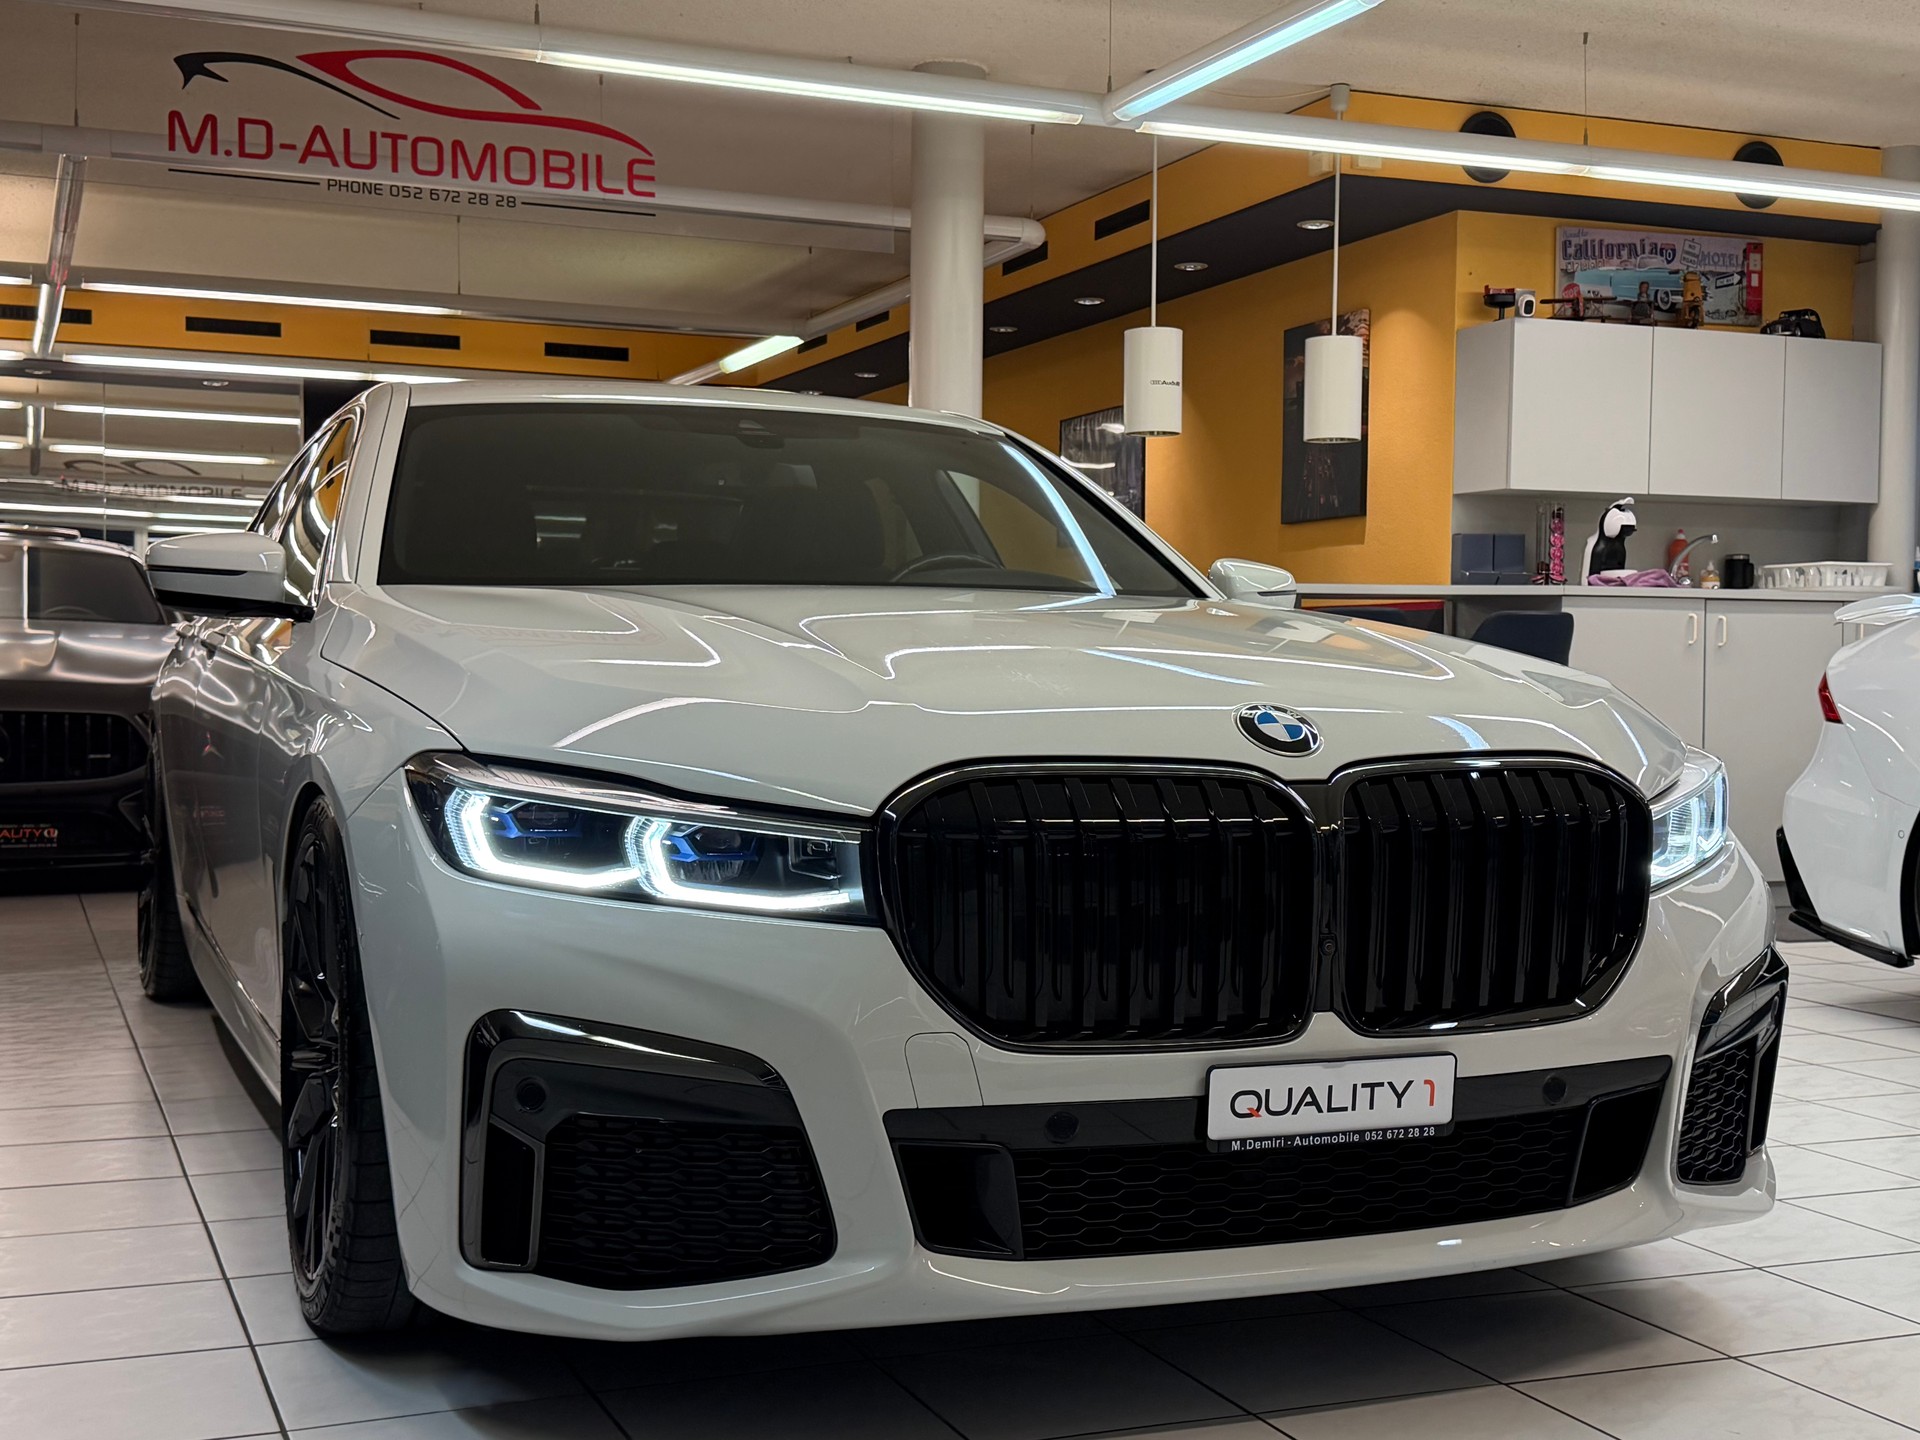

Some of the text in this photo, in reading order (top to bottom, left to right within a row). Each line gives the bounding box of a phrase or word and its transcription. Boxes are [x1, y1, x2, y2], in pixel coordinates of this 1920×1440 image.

[168, 110, 656, 198] M.D-AUTOMOBILE
[327, 178, 517, 208] PHONE 052 672 28 28
[1562, 239, 1658, 260] California
[1662, 248, 1674, 261] 10
[1700, 251, 1741, 267] MOTEL
[1240, 704, 1302, 719] BMW
[1230, 1079, 1436, 1119] QUALITY 1
[1293, 1132, 1360, 1147] Automobile
[1365, 1130, 1383, 1141] 052
[1386, 1128, 1405, 1139] 672
[1407, 1127, 1420, 1138] 28
[1423, 1126, 1435, 1137] 28
